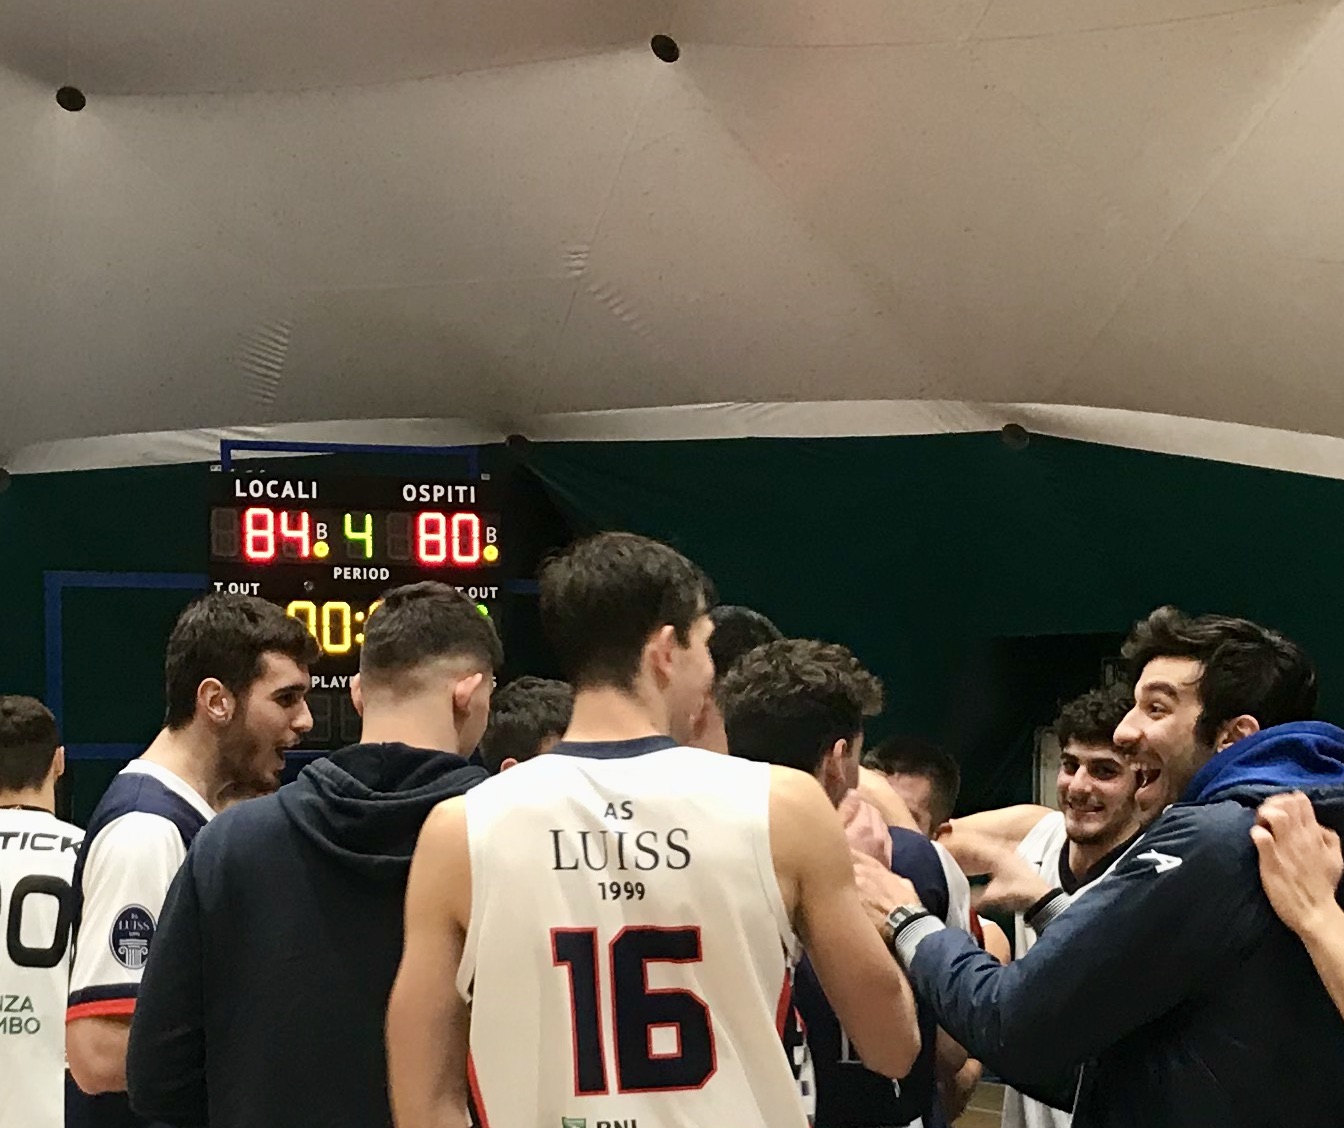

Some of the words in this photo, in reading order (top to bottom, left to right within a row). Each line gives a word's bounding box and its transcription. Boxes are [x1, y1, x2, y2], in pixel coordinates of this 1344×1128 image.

[235, 479, 318, 499] LOCALI
[402, 484, 476, 503] OSPITI
[244, 507, 310, 559] 84
[316, 522, 328, 540] B
[344, 513, 373, 558] 4
[418, 512, 480, 562] 80
[486, 526, 497, 543] B
[333, 567, 390, 580] PERIOD
[455, 586, 499, 599] TOUT
[311, 676, 353, 689] PLAY
[603, 800, 634, 821] AS
[549, 827, 692, 871] LUISS
[597, 881, 646, 901] 1999
[549, 925, 718, 1097] 16
